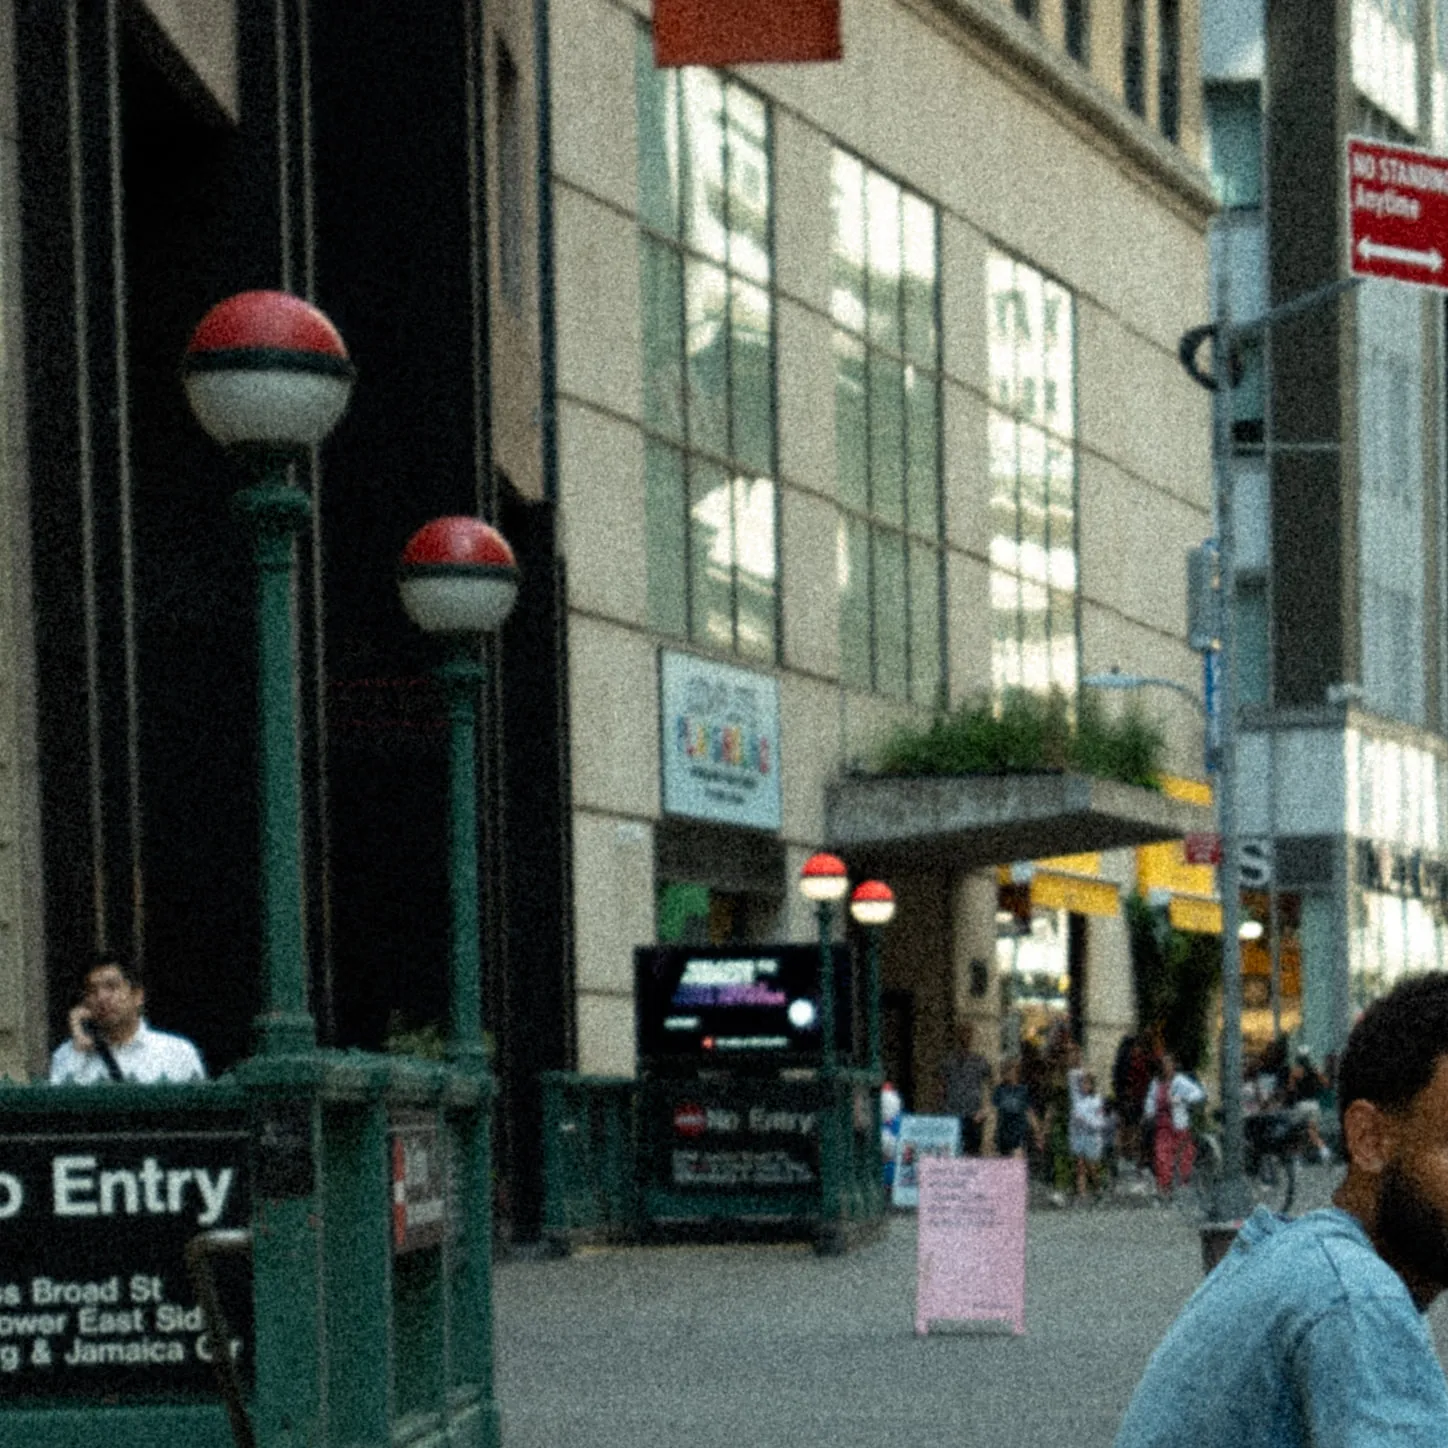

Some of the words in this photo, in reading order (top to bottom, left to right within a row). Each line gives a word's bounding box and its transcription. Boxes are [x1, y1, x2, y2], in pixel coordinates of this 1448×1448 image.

[1352, 152, 1377, 181] NO
[706, 1107, 740, 1132] No
[749, 1107, 818, 1137] Entry
[53, 1154, 234, 1226] Entry
[32, 1275, 119, 1304] Broad
[130, 1274, 163, 1302] St
[0, 1312, 68, 1336] ower
[78, 1306, 145, 1334] East
[155, 1303, 205, 1333] Sid
[31, 1337, 51, 1365] &
[64, 1336, 185, 1366] Jamaica
[195, 1333, 243, 1363] Cr
